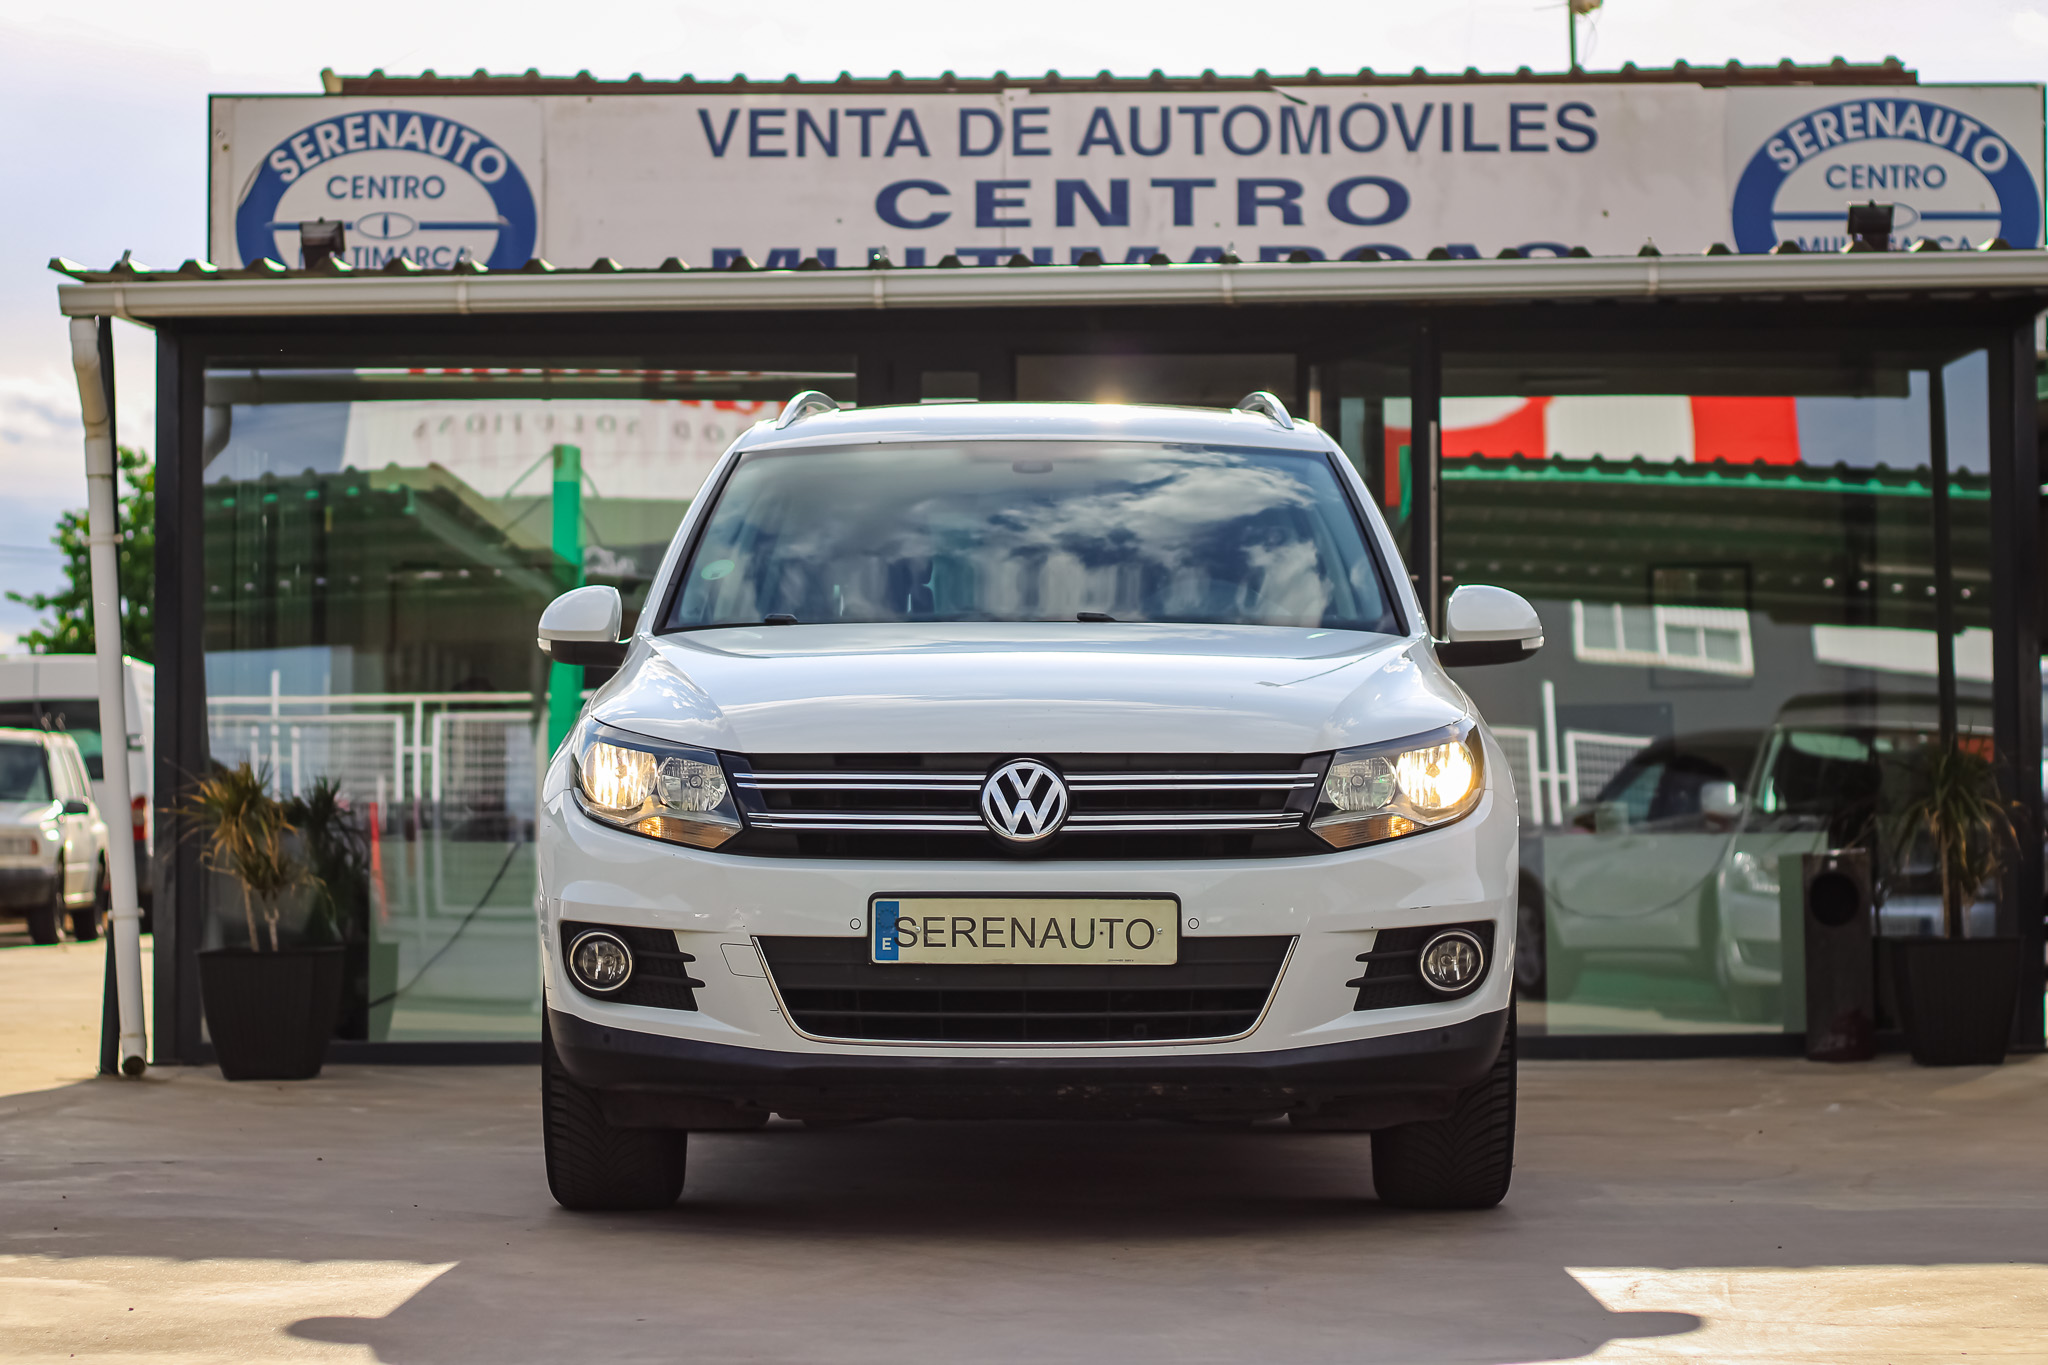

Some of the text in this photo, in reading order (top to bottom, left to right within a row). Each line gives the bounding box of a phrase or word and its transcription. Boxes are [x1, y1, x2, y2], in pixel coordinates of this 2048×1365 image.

[270, 114, 508, 183] SERENAUTO
[698, 102, 1600, 158] VENTA DE AUTOMOVILES
[1766, 102, 2009, 173] SERENAUTO
[326, 175, 446, 200] CENTRO
[875, 176, 1411, 230] CENTRO
[1824, 164, 1948, 190] CENTRO
[985, 762, 1063, 838] VW
[882, 937, 892, 951] E
[894, 915, 1155, 950] SERENAUTO
